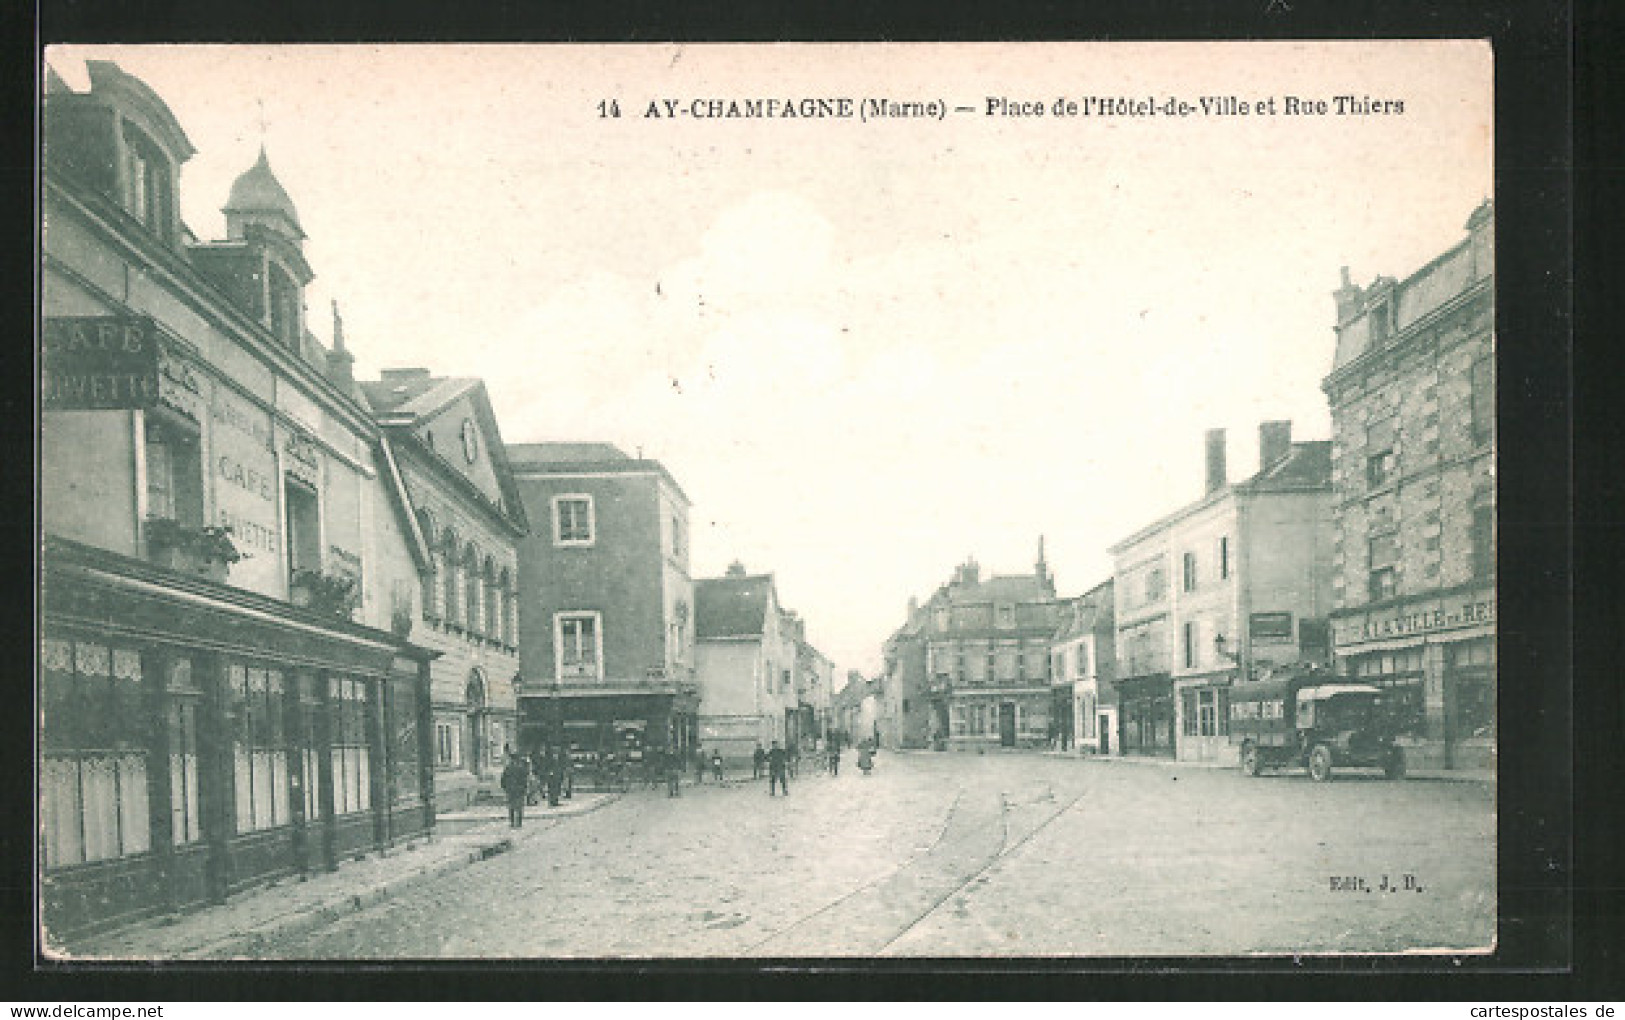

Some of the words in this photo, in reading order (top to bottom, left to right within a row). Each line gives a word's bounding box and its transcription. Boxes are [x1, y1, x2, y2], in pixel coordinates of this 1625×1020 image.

[598, 101, 621, 117] 14
[644, 99, 853, 117] AY-CHAMPAGNE
[861, 99, 947, 122] (Marne)
[986, 99, 1043, 116] Place
[1053, 98, 1078, 116] de
[1084, 97, 1250, 116] l'Hôtel-de-Ville
[1256, 99, 1276, 116] et
[1285, 97, 1328, 116] Rue
[1332, 96, 1404, 115] Thiers
